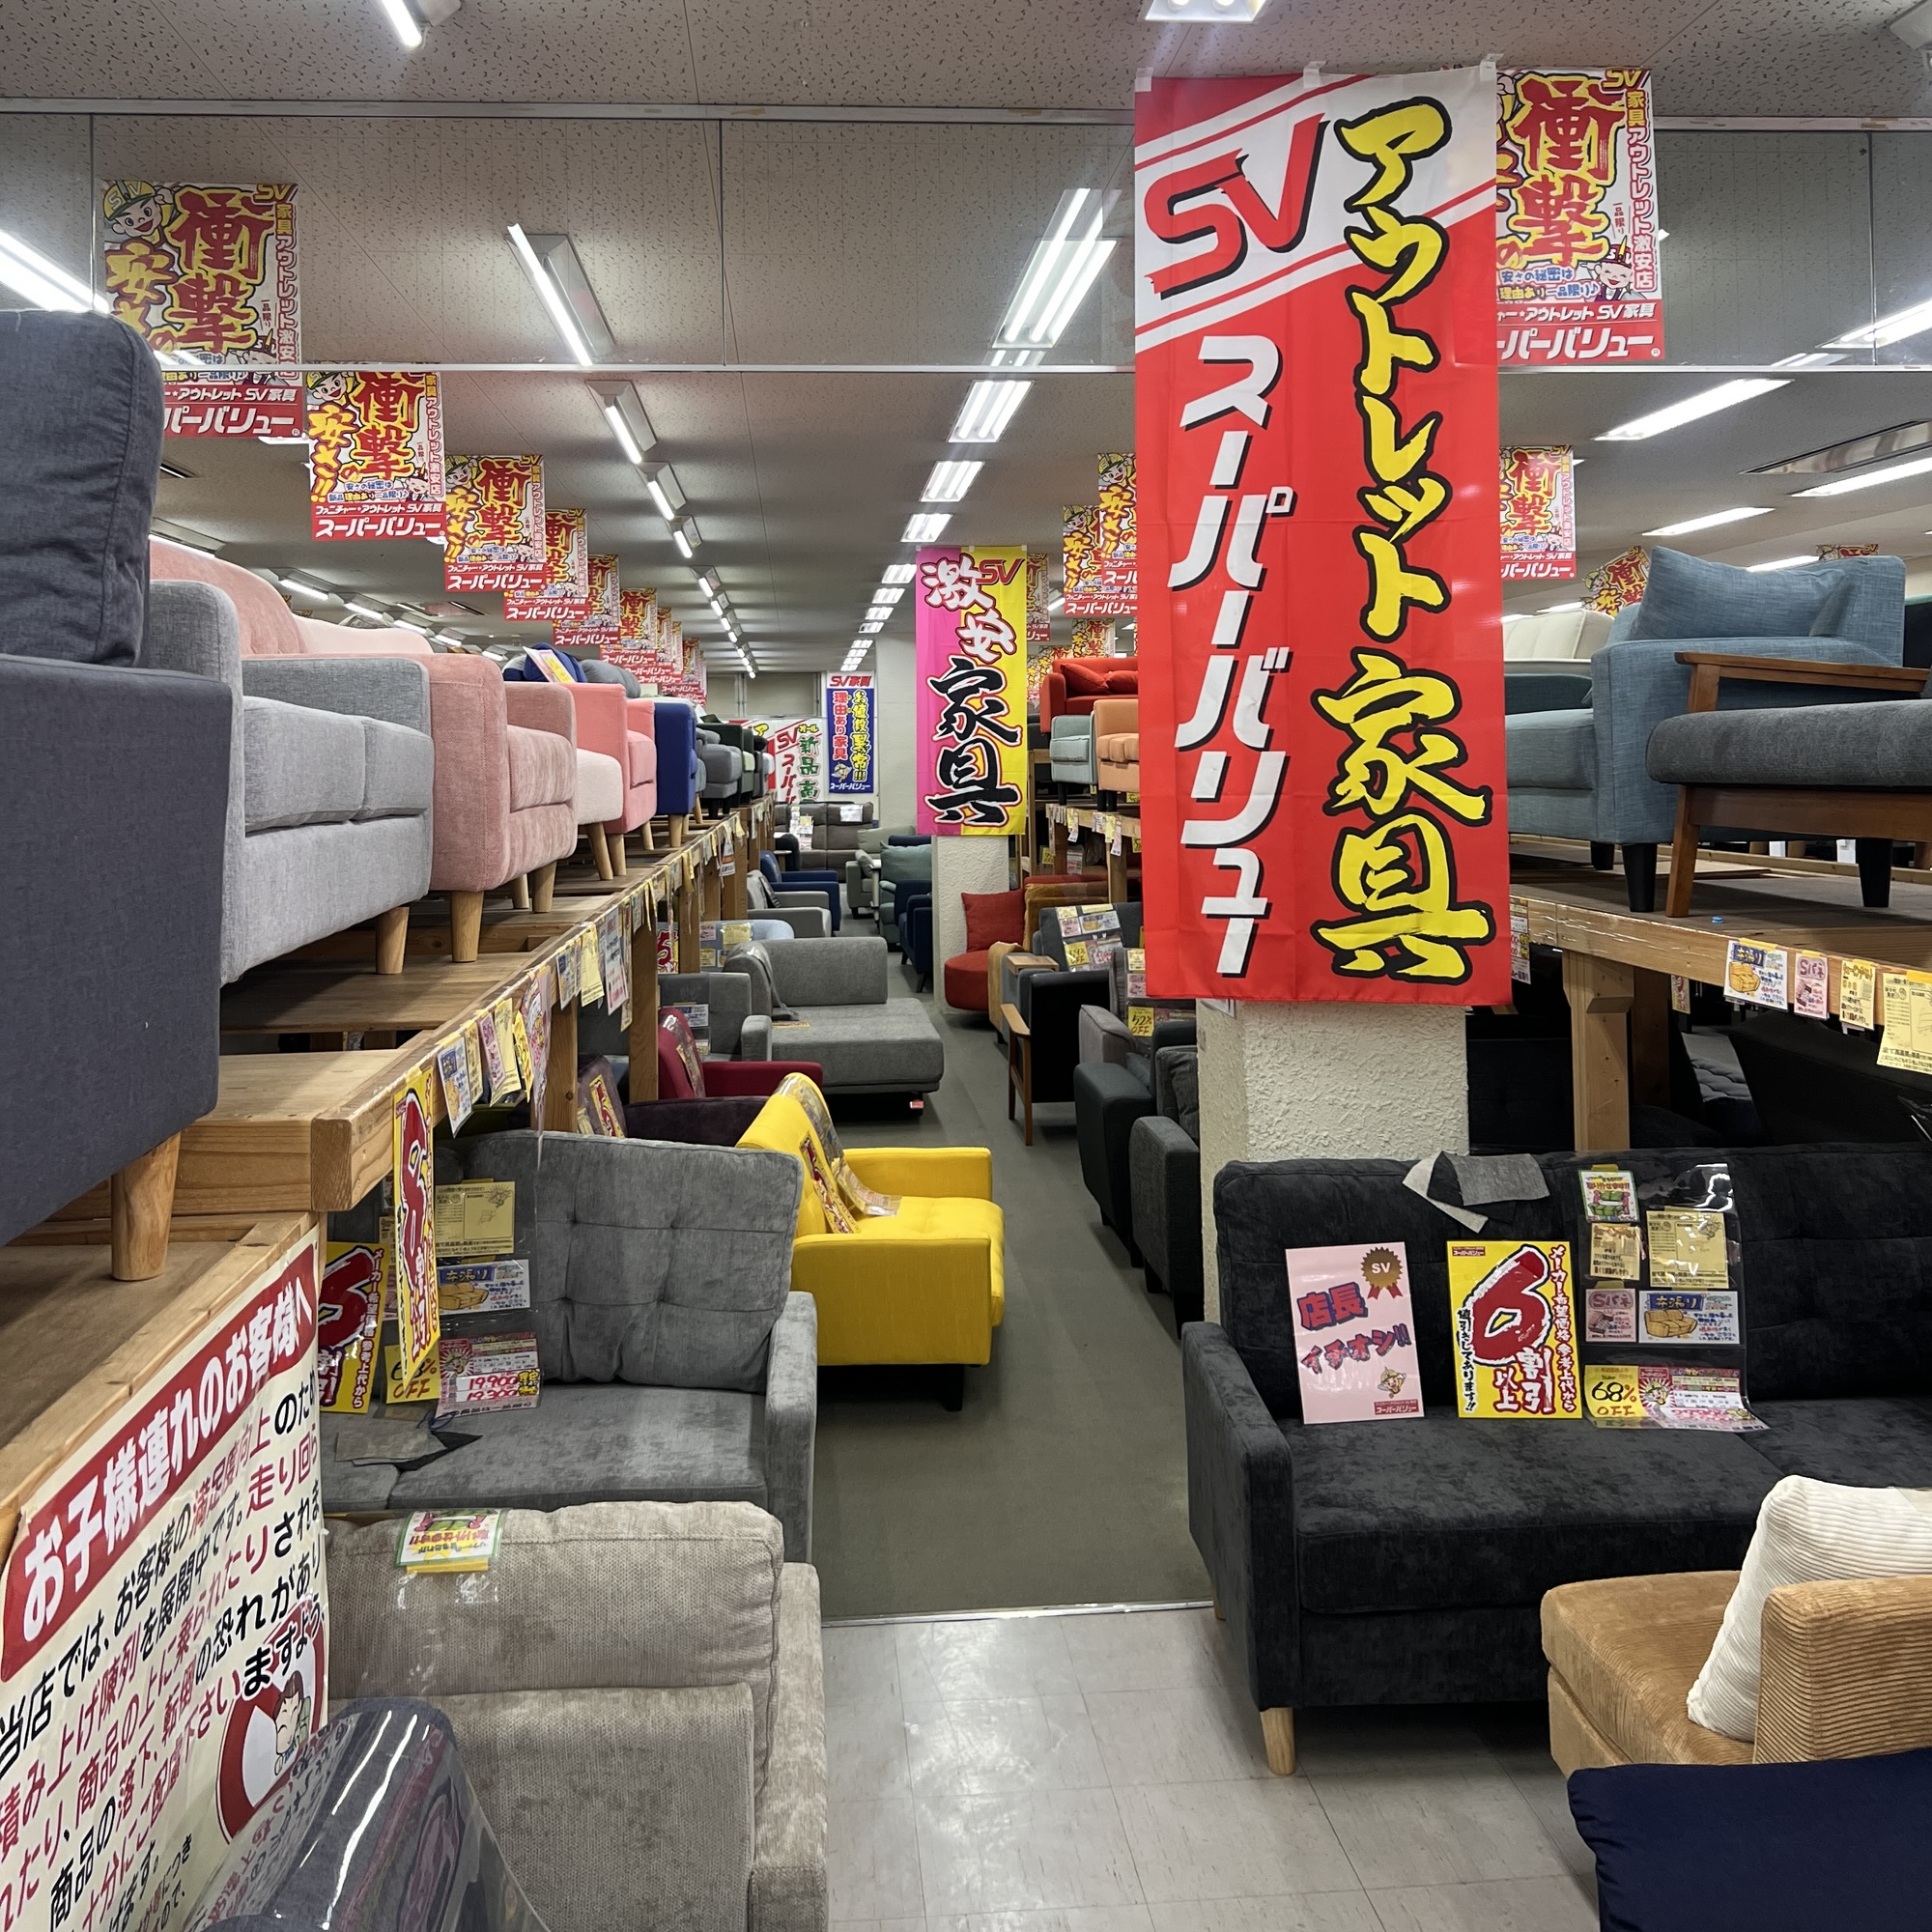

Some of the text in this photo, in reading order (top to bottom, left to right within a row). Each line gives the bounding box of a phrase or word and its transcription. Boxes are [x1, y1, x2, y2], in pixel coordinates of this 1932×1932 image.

[1603, 69, 1639, 88] SV
[254, 184, 291, 201] SV
[1144, 112, 1329, 298] SV
[1502, 266, 1573, 282] 安さの秘密は
[316, 517, 441, 537] スーパーバリュー
[1314, 97, 1493, 983] アウトレット家具
[448, 574, 542, 590] スーパーバリュー
[978, 558, 1025, 585] SV
[1501, 563, 1572, 579] パーバリュー
[506, 607, 585, 619] スーパーバリュー
[1065, 601, 1137, 614] スーパーバリュー
[554, 635, 618, 645] スーパーバリュー
[1167, 335, 1298, 979] スーパーバリュー
[830, 675, 872, 688] SV家具
[922, 554, 1023, 826] 激安家具
[833, 691, 849, 761] 理由あり家具
[777, 726, 799, 751] SV
[799, 735, 820, 804] 新品高
[829, 782, 871, 791] スーパーバリュー
[1131, 1025, 1150, 1035] OFF
[1371, 1262, 1391, 1274] SV
[1296, 1282, 1369, 1331] 店長
[1463, 1245, 1553, 1365] 6
[1550, 1244, 1577, 1412] メーカー希望価格 参考上代から
[1301, 1323, 1412, 1375] イチオシ!!
[1493, 1366, 1522, 1412] 以上
[1517, 1346, 1555, 1413] 割引
[1591, 1380, 1637, 1403] 68%
[1376, 1405, 1418, 1414] スーパーバリュー
[1597, 1406, 1635, 1416] OFF
[23, 1275, 313, 1642] お子様連れのお客様へ
